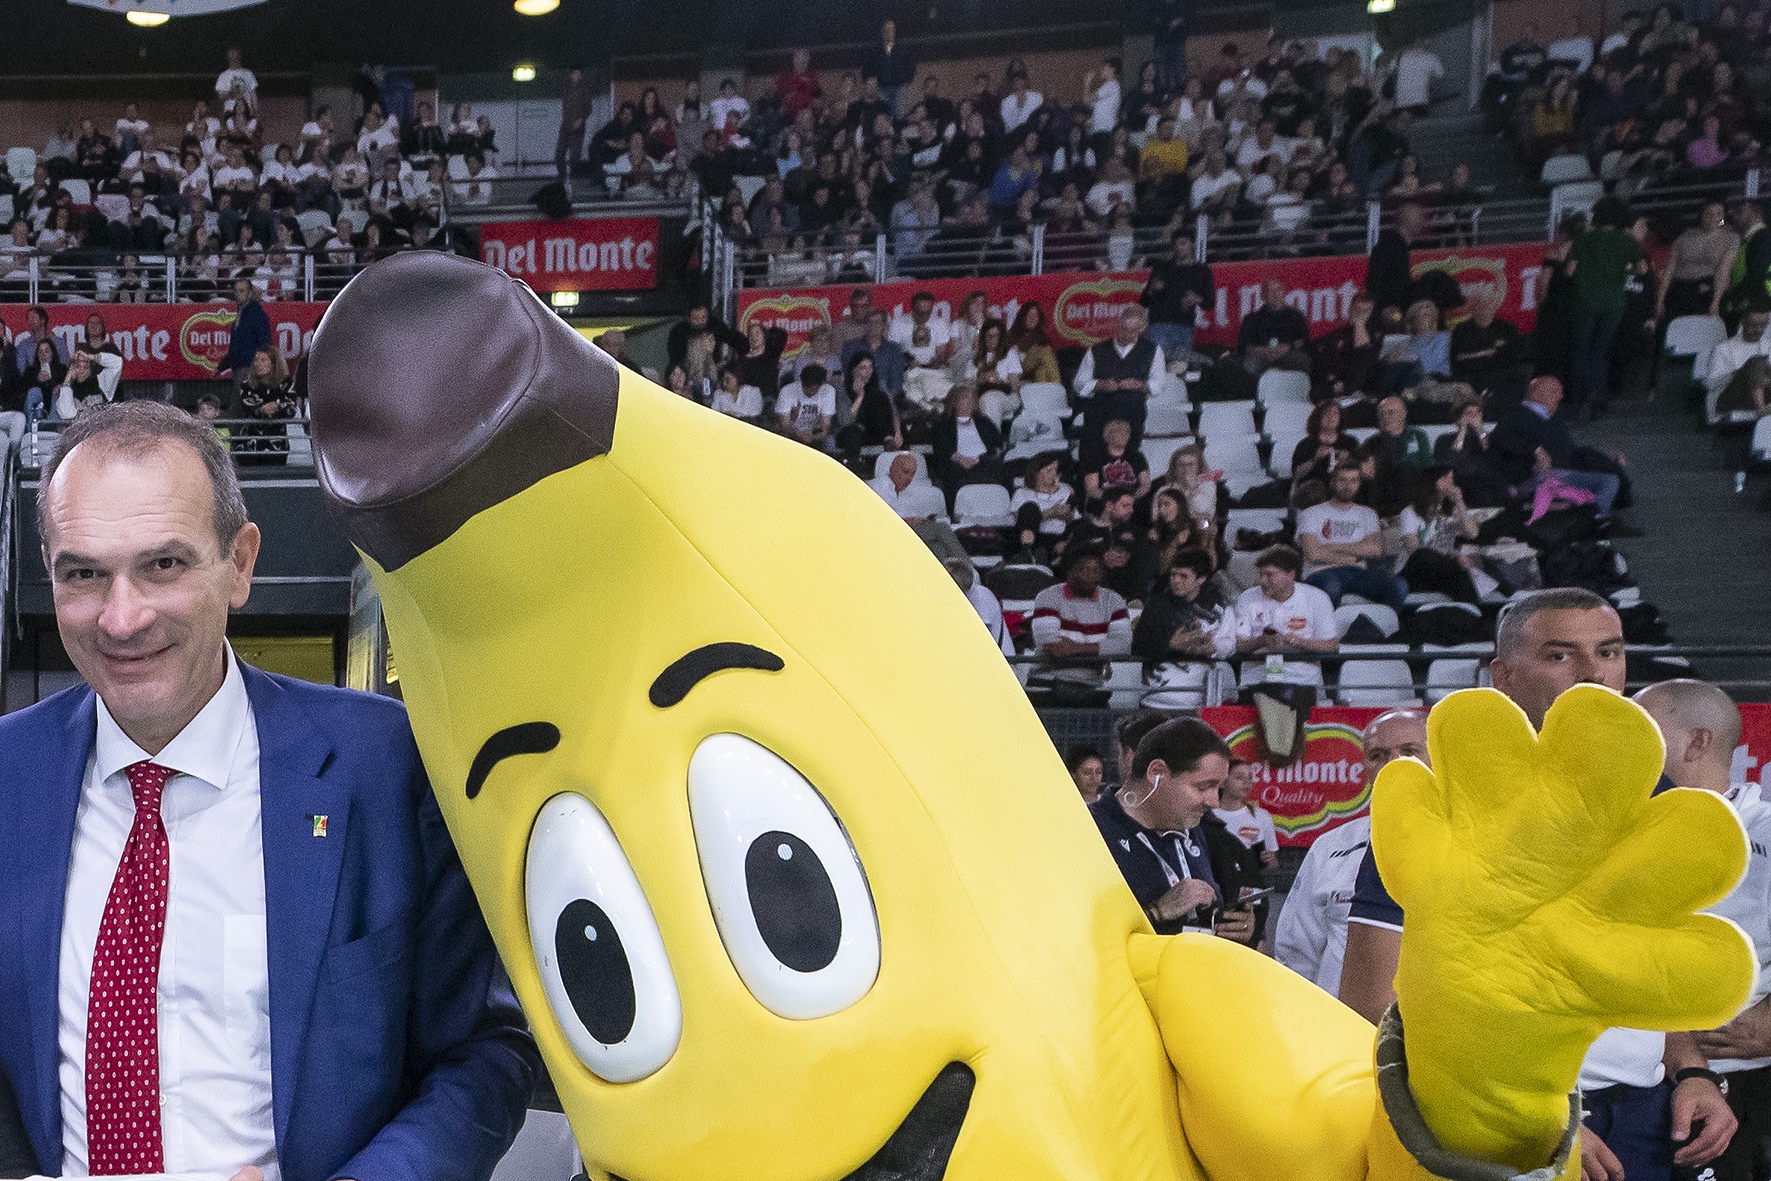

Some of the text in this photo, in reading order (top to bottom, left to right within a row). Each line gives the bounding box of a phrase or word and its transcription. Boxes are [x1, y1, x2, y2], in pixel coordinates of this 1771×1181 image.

[484, 236, 654, 273] Del Monte
[51, 323, 171, 361] Mnte
